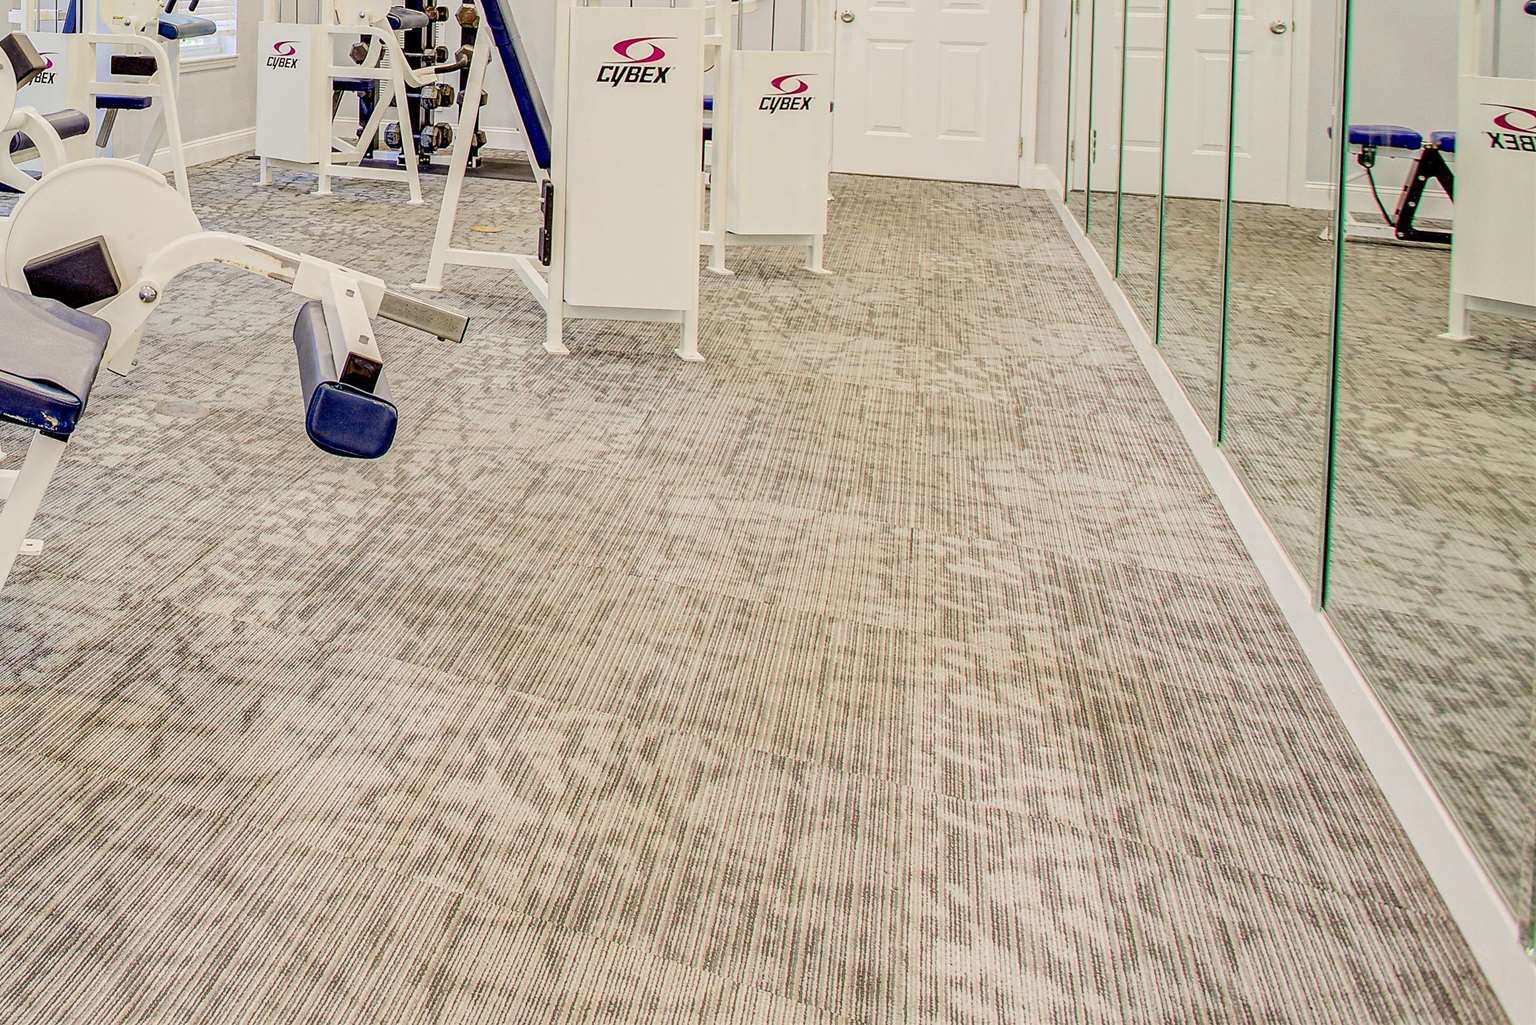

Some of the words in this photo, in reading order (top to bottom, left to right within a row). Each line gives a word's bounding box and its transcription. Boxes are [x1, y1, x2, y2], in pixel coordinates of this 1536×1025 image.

[266, 57, 298, 69] CYBEX
[29, 72, 55, 85] BEX
[596, 65, 671, 87] CYBEX
[758, 97, 812, 114] CYBEX
